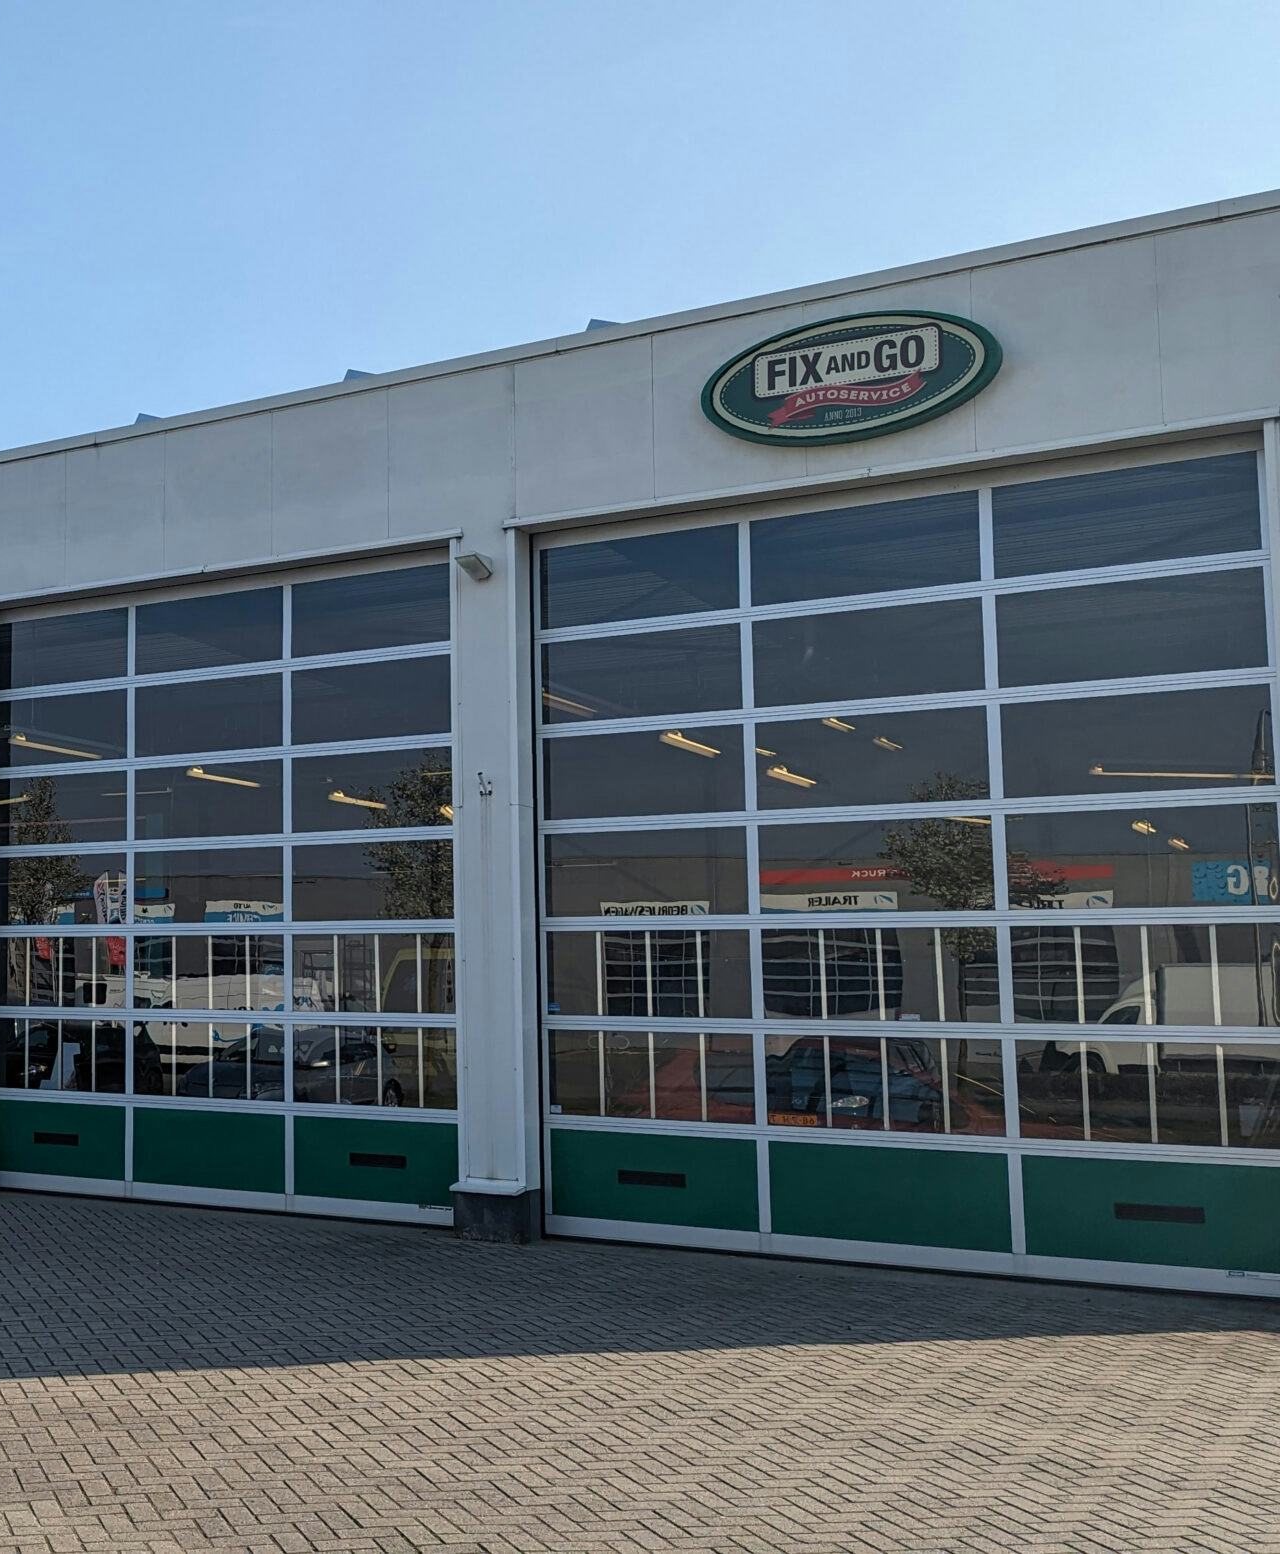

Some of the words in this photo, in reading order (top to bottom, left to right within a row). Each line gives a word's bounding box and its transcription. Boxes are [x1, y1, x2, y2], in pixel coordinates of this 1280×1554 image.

[767, 352, 824, 390] FIX
[826, 350, 871, 375] AND
[874, 334, 925, 373] GO
[795, 382, 912, 407] AUTOSERVICE
[824, 409, 843, 421] ANNO
[845, 408, 862, 419] 2013
